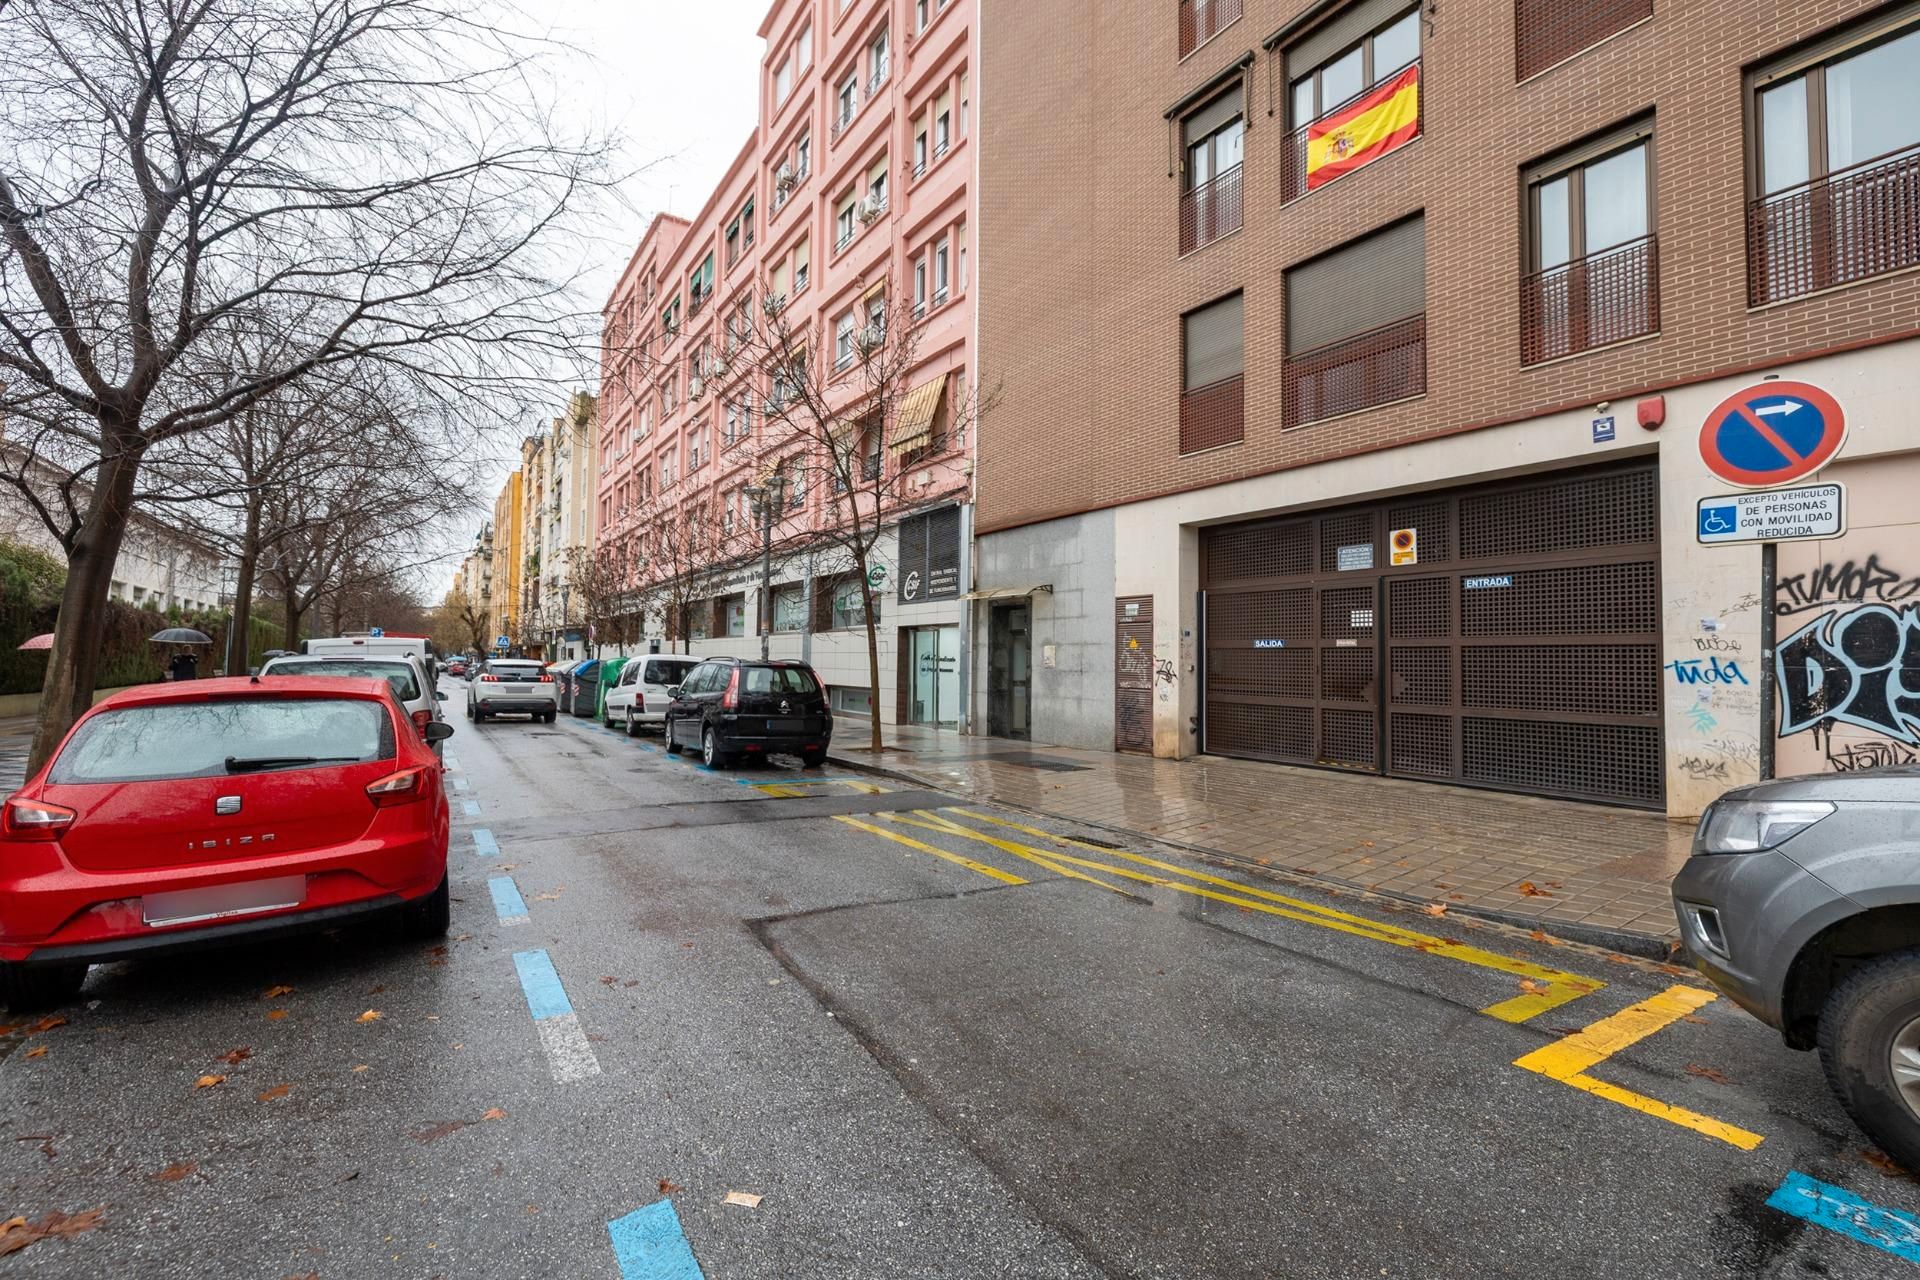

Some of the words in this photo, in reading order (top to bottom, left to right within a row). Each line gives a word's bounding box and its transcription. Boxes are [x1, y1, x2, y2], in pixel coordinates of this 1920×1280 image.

[1738, 494, 1778, 505] EXCEPTO
[1782, 488, 1836, 500] VEHÍCULOS
[1746, 506, 1760, 516] DE
[1765, 500, 1827, 514] PERSONAS
[1741, 518, 1763, 528] CON
[1768, 512, 1833, 526] MOVILIDAD
[1757, 526, 1813, 538] REDUCIDA
[1466, 577, 1510, 588] ENTRADA
[1255, 639, 1283, 648] SALIDA
[189, 833, 275, 850] IBIZA
